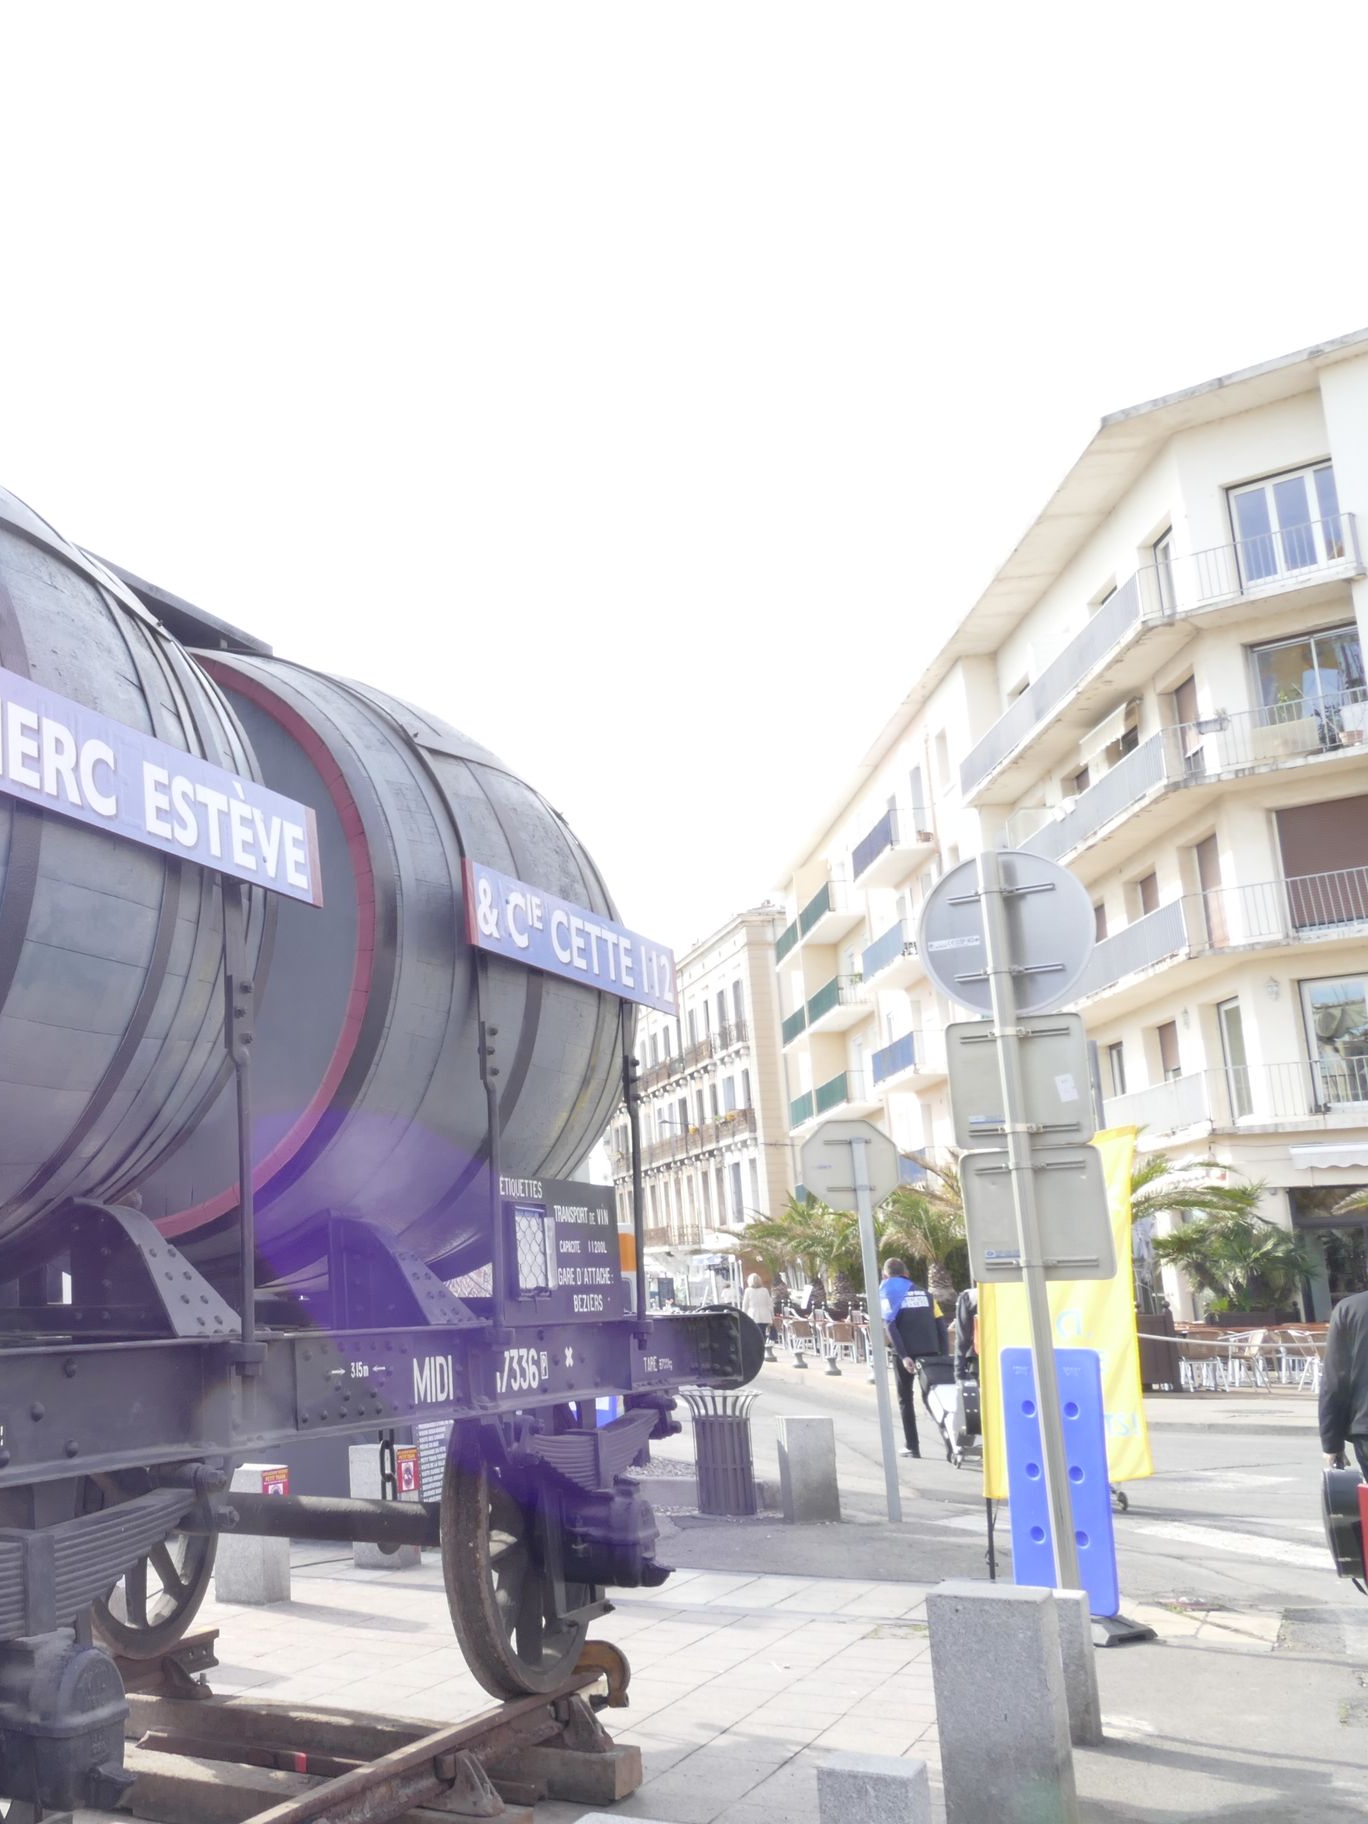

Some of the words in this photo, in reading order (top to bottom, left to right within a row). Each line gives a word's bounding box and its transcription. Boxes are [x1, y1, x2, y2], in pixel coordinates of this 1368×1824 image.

[142, 780, 310, 890] ESTÈVE
[476, 878, 501, 939] &
[550, 909, 635, 989] CETTE
[640, 945, 674, 1003] 112
[553, 1205, 588, 1224] TRANSPORT
[588, 1211, 596, 1225] DE
[596, 1208, 609, 1226] VIN
[557, 1267, 575, 1285] GARE
[573, 1293, 604, 1312] BEZIERS
[643, 1356, 658, 1372] TARE
[413, 1354, 454, 1405] MIDI
[496, 1348, 539, 1393] 7336
